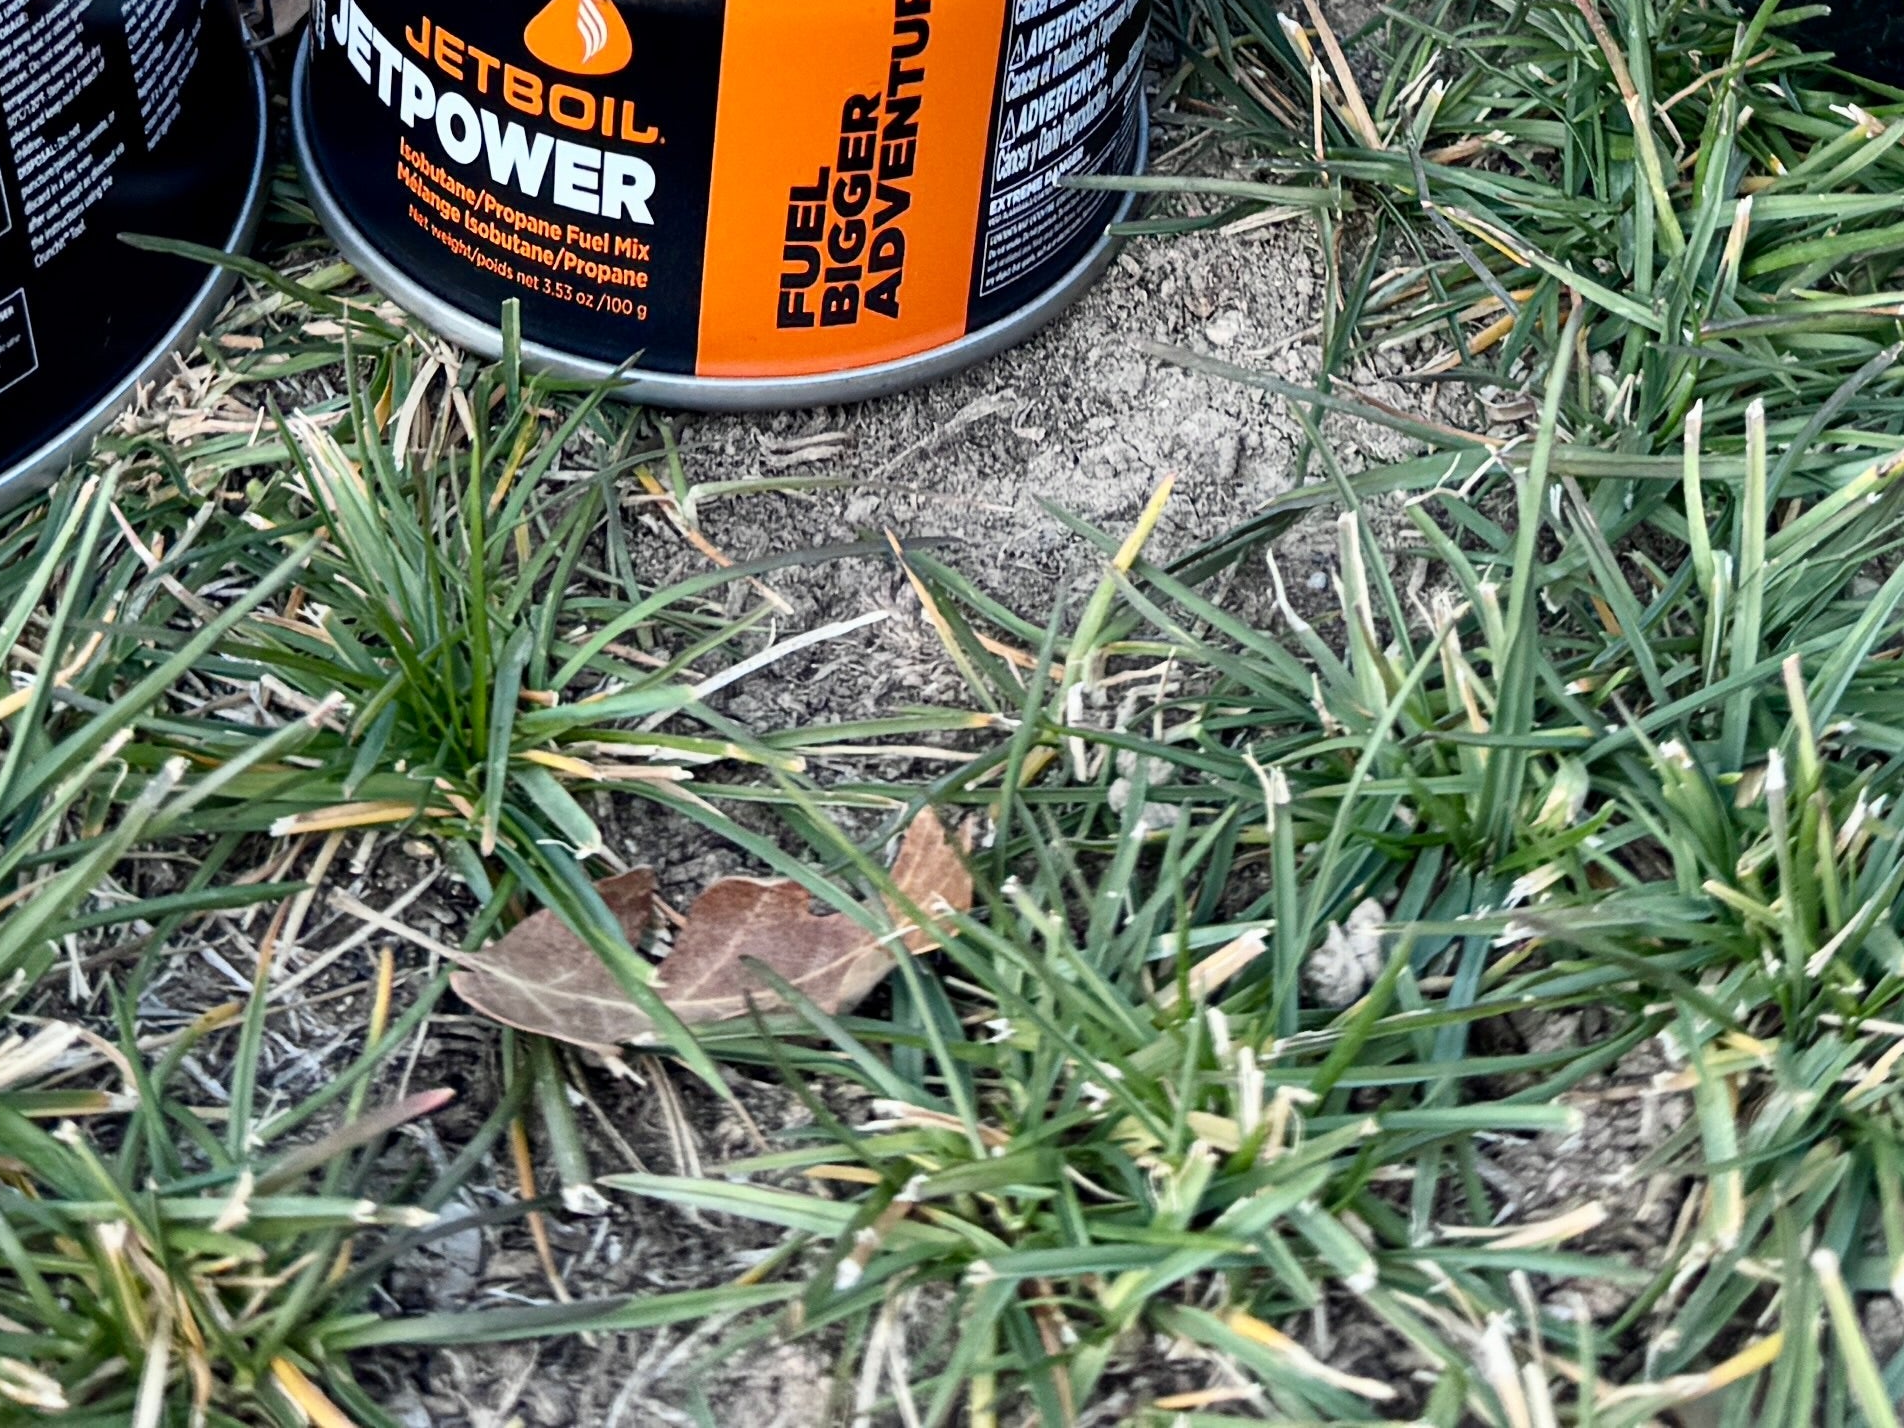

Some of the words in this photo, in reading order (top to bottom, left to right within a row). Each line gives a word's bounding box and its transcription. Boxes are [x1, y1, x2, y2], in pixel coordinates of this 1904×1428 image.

[1016, 51, 1109, 138] ADVERTENCIA:
[397, 160, 461, 224] Mélange
[464, 204, 649, 289] Isobutane/Propane
[399, 135, 563, 241] Isobutane/Propane
[566, 225, 609, 254] Fuel
[614, 235, 651, 262] Mix
[408, 203, 430, 232] Net
[431, 226, 514, 282] weight/poids
[516, 270, 540, 291] net
[542, 277, 573, 301] 3.53
[576, 289, 594, 307] oz
[636, 303, 648, 321] g
[776, 166, 830, 328] FUEL
[820, 91, 883, 327] BIGGER
